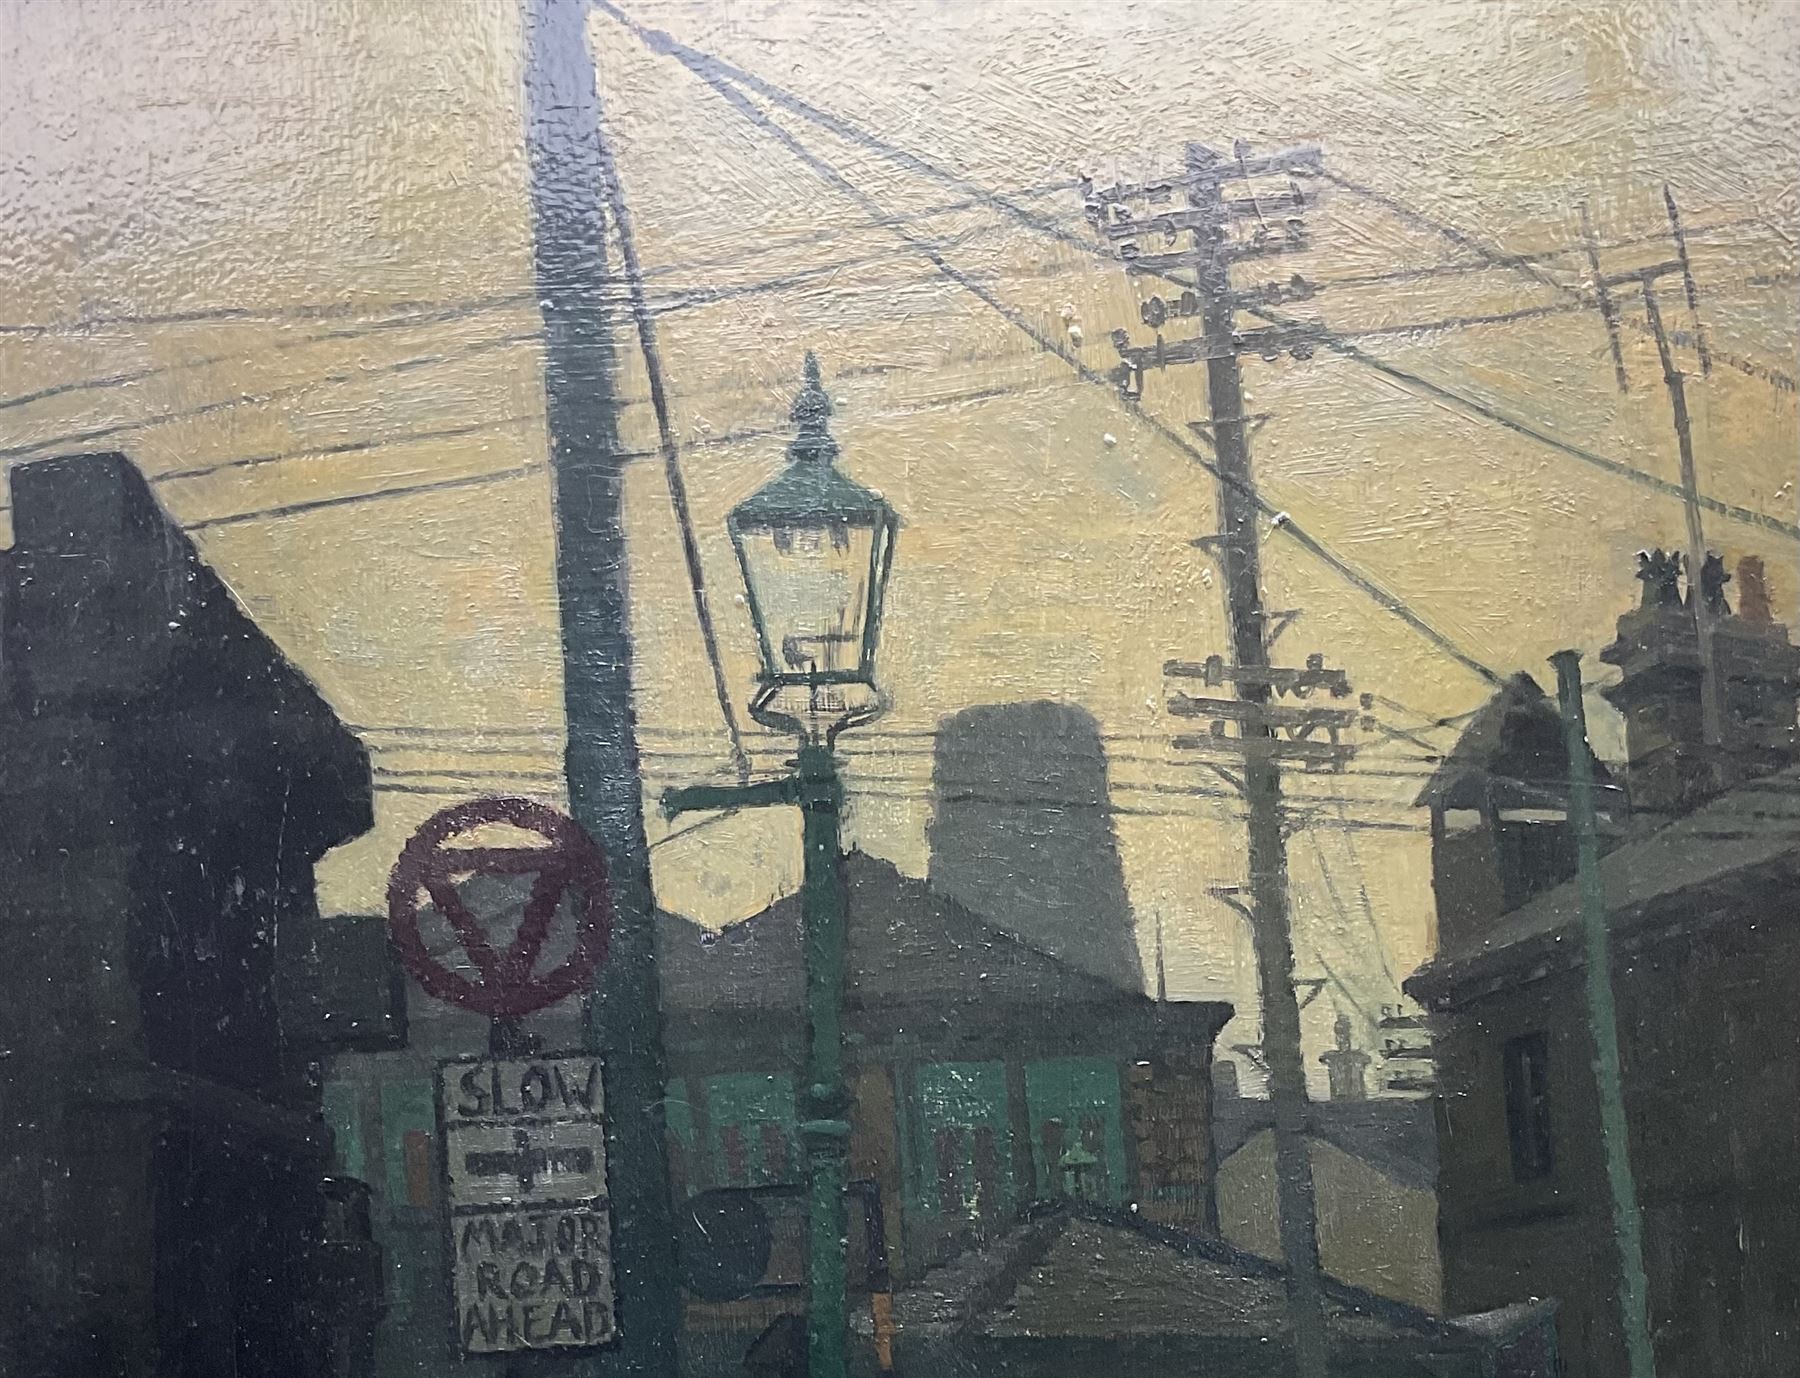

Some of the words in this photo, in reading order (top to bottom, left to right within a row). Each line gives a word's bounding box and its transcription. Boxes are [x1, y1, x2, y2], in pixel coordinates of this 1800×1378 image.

[459, 1063, 604, 1116] SLOW
[463, 1214, 606, 1260] MAJOR
[478, 1260, 601, 1299] ROAD
[462, 1301, 611, 1347] AHEAD
